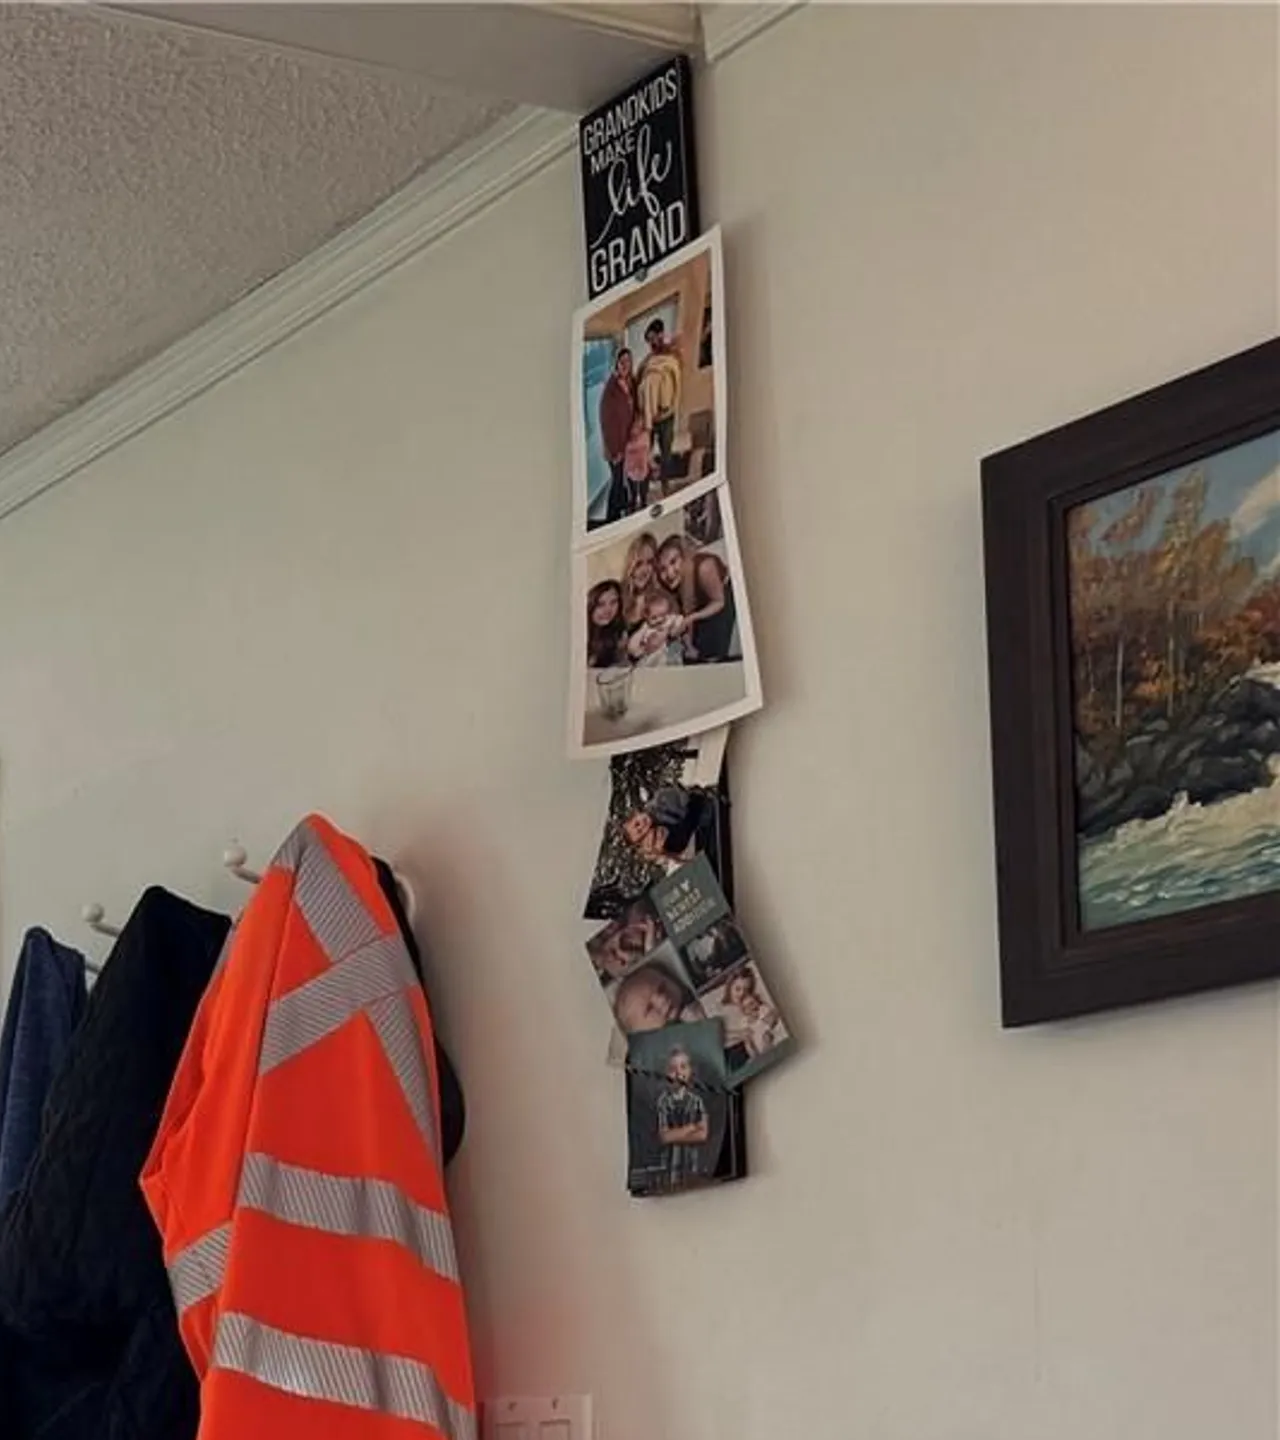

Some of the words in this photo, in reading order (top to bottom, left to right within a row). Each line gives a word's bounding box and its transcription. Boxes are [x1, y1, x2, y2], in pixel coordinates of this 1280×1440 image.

[583, 67, 677, 155] GRANDKIDS
[590, 129, 635, 175] MAKE
[590, 123, 672, 248] life
[590, 201, 685, 292] GRAND
